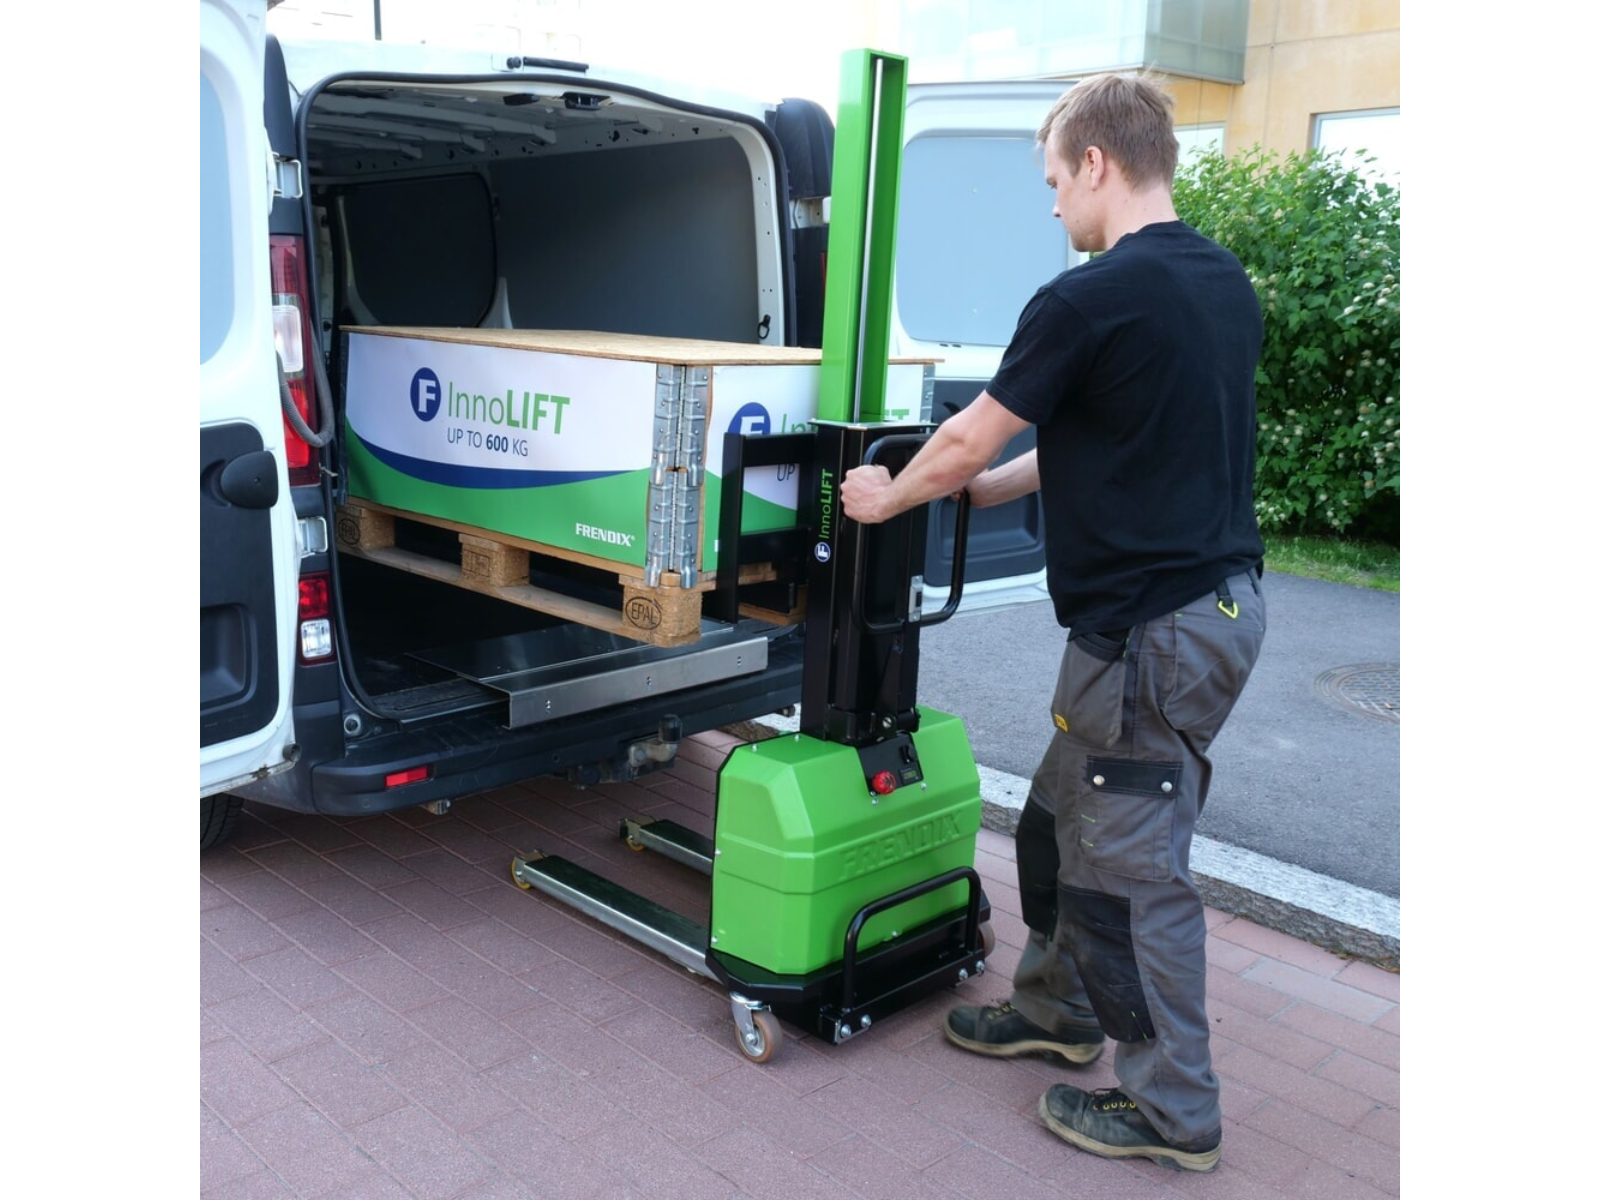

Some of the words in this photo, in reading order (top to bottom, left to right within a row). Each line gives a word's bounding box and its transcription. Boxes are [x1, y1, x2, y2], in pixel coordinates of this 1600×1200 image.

[418, 378, 437, 414] F
[448, 381, 571, 435] InnoLIFT
[447, 427, 463, 444] UP
[467, 430, 483, 448] TO
[486, 433, 509, 453] 600
[512, 438, 529, 457] KG
[776, 463, 796, 482] UP
[818, 468, 833, 539] InnoLIFT
[631, 602, 657, 625] EPAL
[838, 809, 962, 882] FRENDIX
